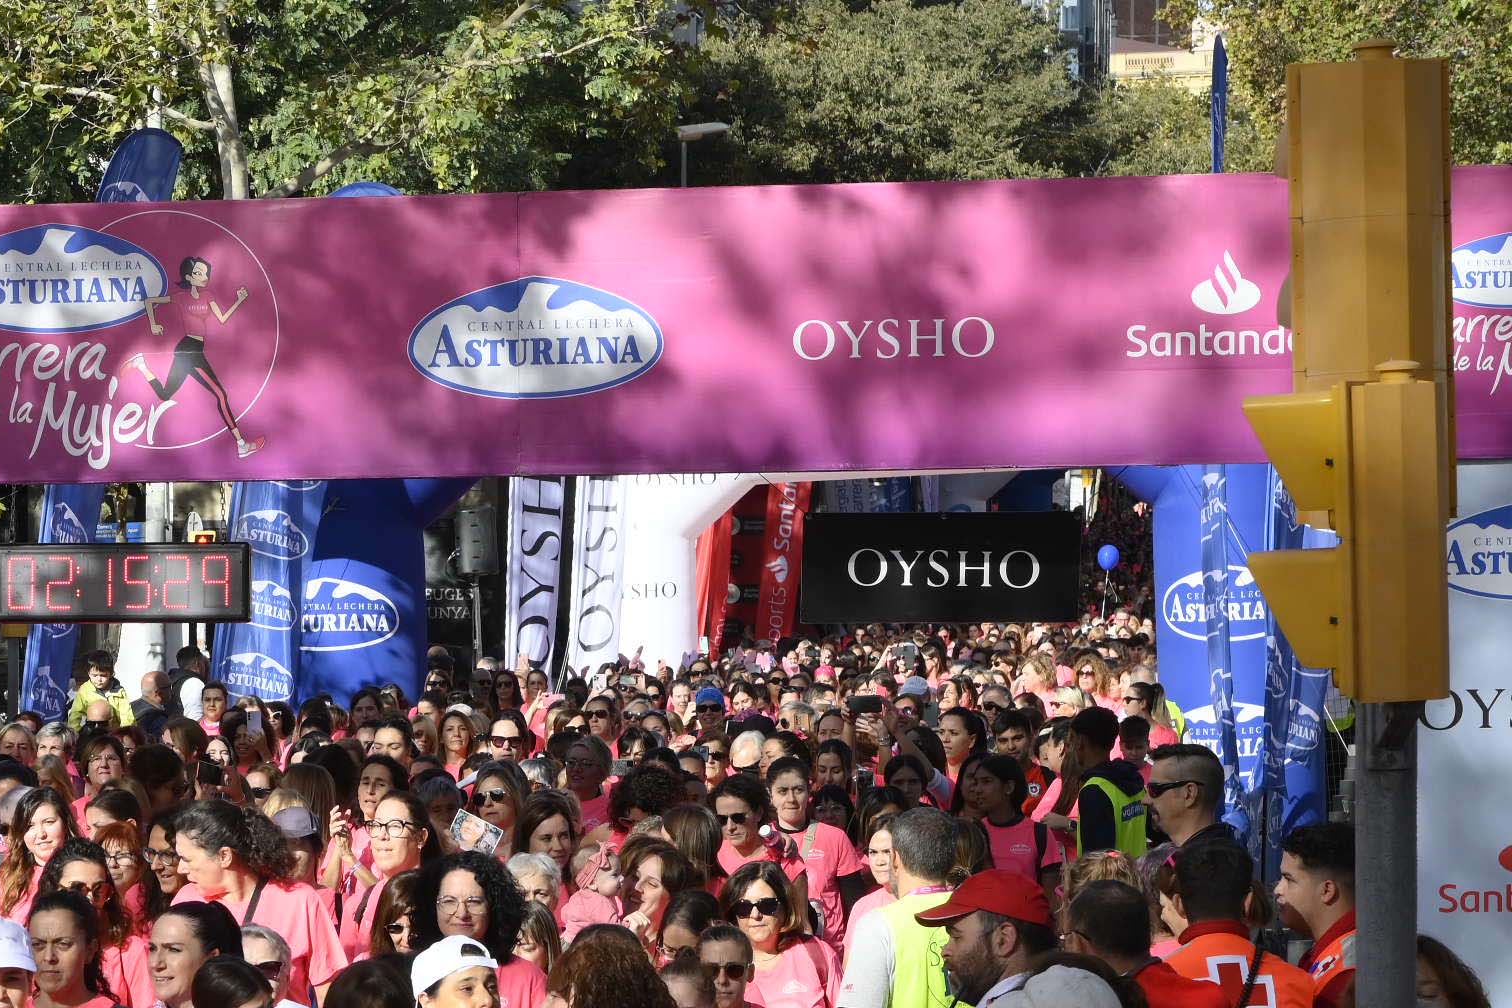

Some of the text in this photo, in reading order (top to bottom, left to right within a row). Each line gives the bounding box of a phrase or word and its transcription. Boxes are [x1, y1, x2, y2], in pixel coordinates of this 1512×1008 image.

[71, 260, 143, 271] LECHERA
[1452, 262, 1512, 289] ASTU
[468, 317, 635, 333] CENTRAL LECHERA
[793, 316, 996, 360] OYSHO
[1126, 323, 1293, 357] Santand
[1453, 315, 1512, 343] arre
[428, 324, 644, 369] ASTURIANA
[1476, 344, 1494, 371] la
[9, 385, 33, 424] la
[29, 375, 176, 470] Mujer
[1474, 537, 1512, 547] CENT
[7, 555, 230, 610] 02:15:29
[517, 476, 560, 666] OYSH
[578, 476, 617, 652] OYSH
[847, 549, 1040, 590] OYSHO
[1419, 689, 1512, 731] OY
[1439, 883, 1512, 913] Sant
